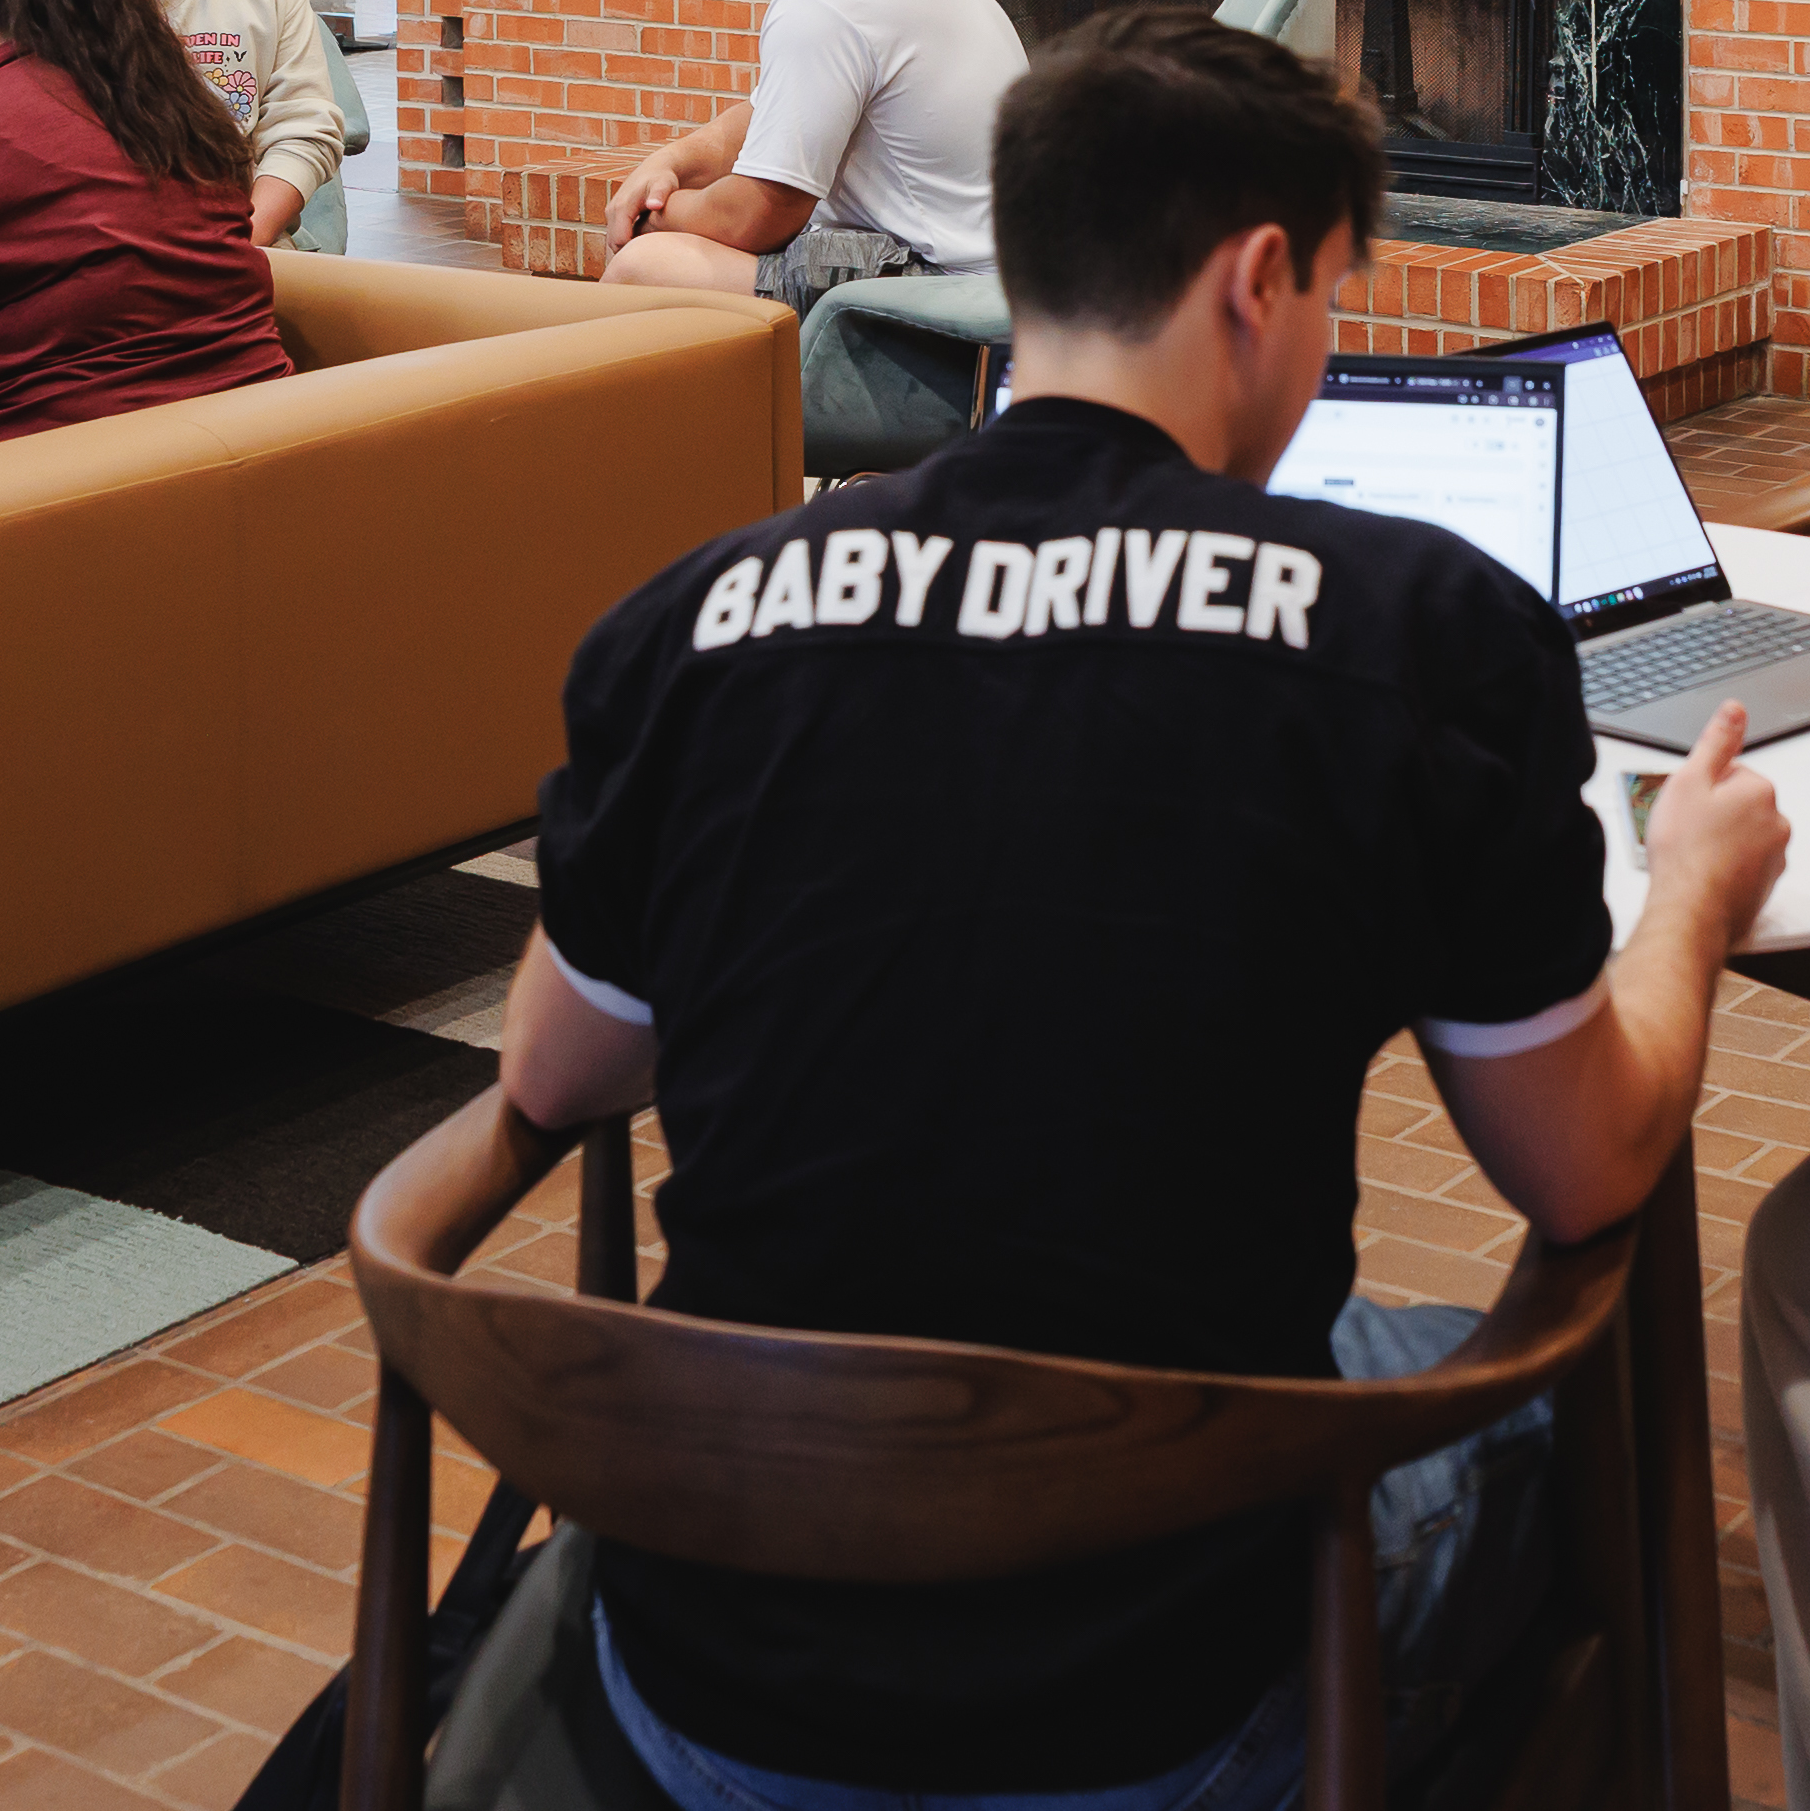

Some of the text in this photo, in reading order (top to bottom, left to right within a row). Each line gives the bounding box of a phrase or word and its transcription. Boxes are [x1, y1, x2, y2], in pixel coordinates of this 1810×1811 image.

[220, 33, 240, 47] IN
[693, 527, 1322, 651] BABY DRIVER
